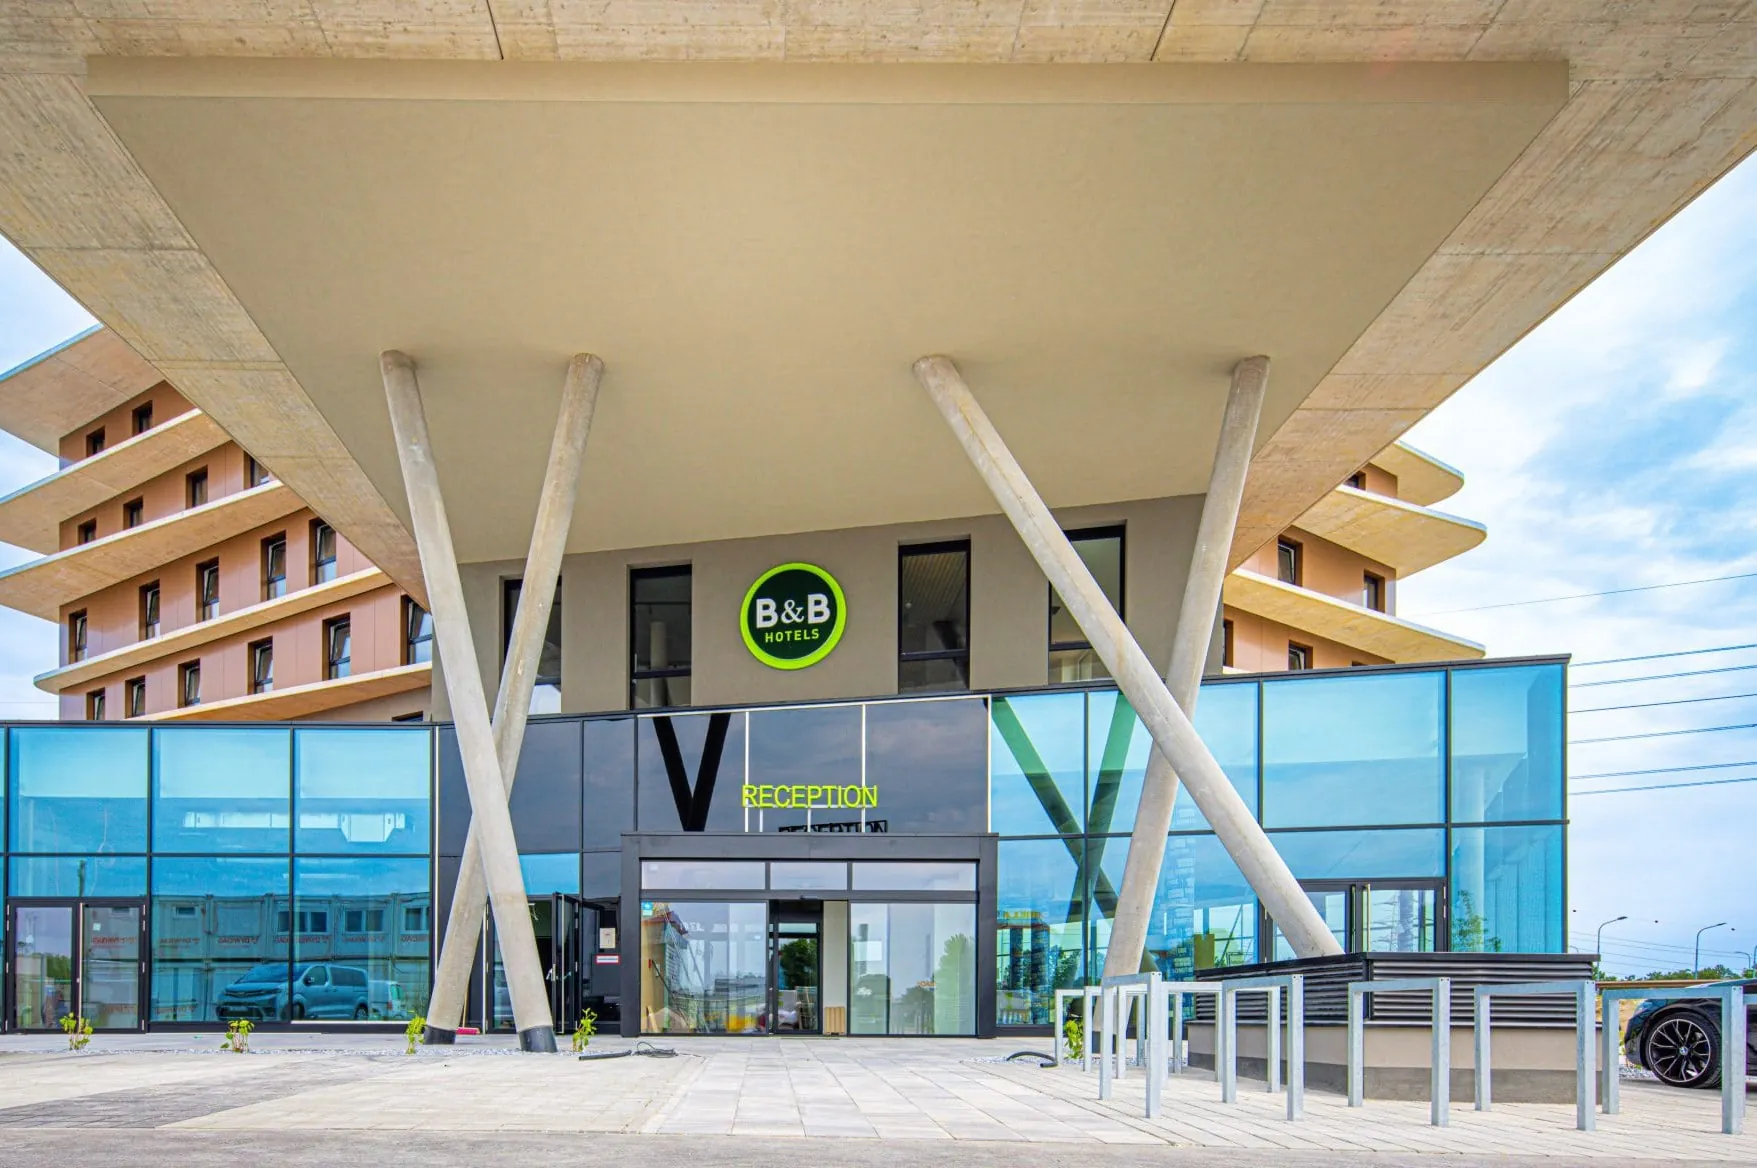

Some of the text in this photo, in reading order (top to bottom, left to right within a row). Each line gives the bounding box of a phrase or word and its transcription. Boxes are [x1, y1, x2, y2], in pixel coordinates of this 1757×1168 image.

[756, 593, 831, 629] B&B
[764, 628, 820, 643] HOTELS
[742, 784, 878, 808] RECEPTION
